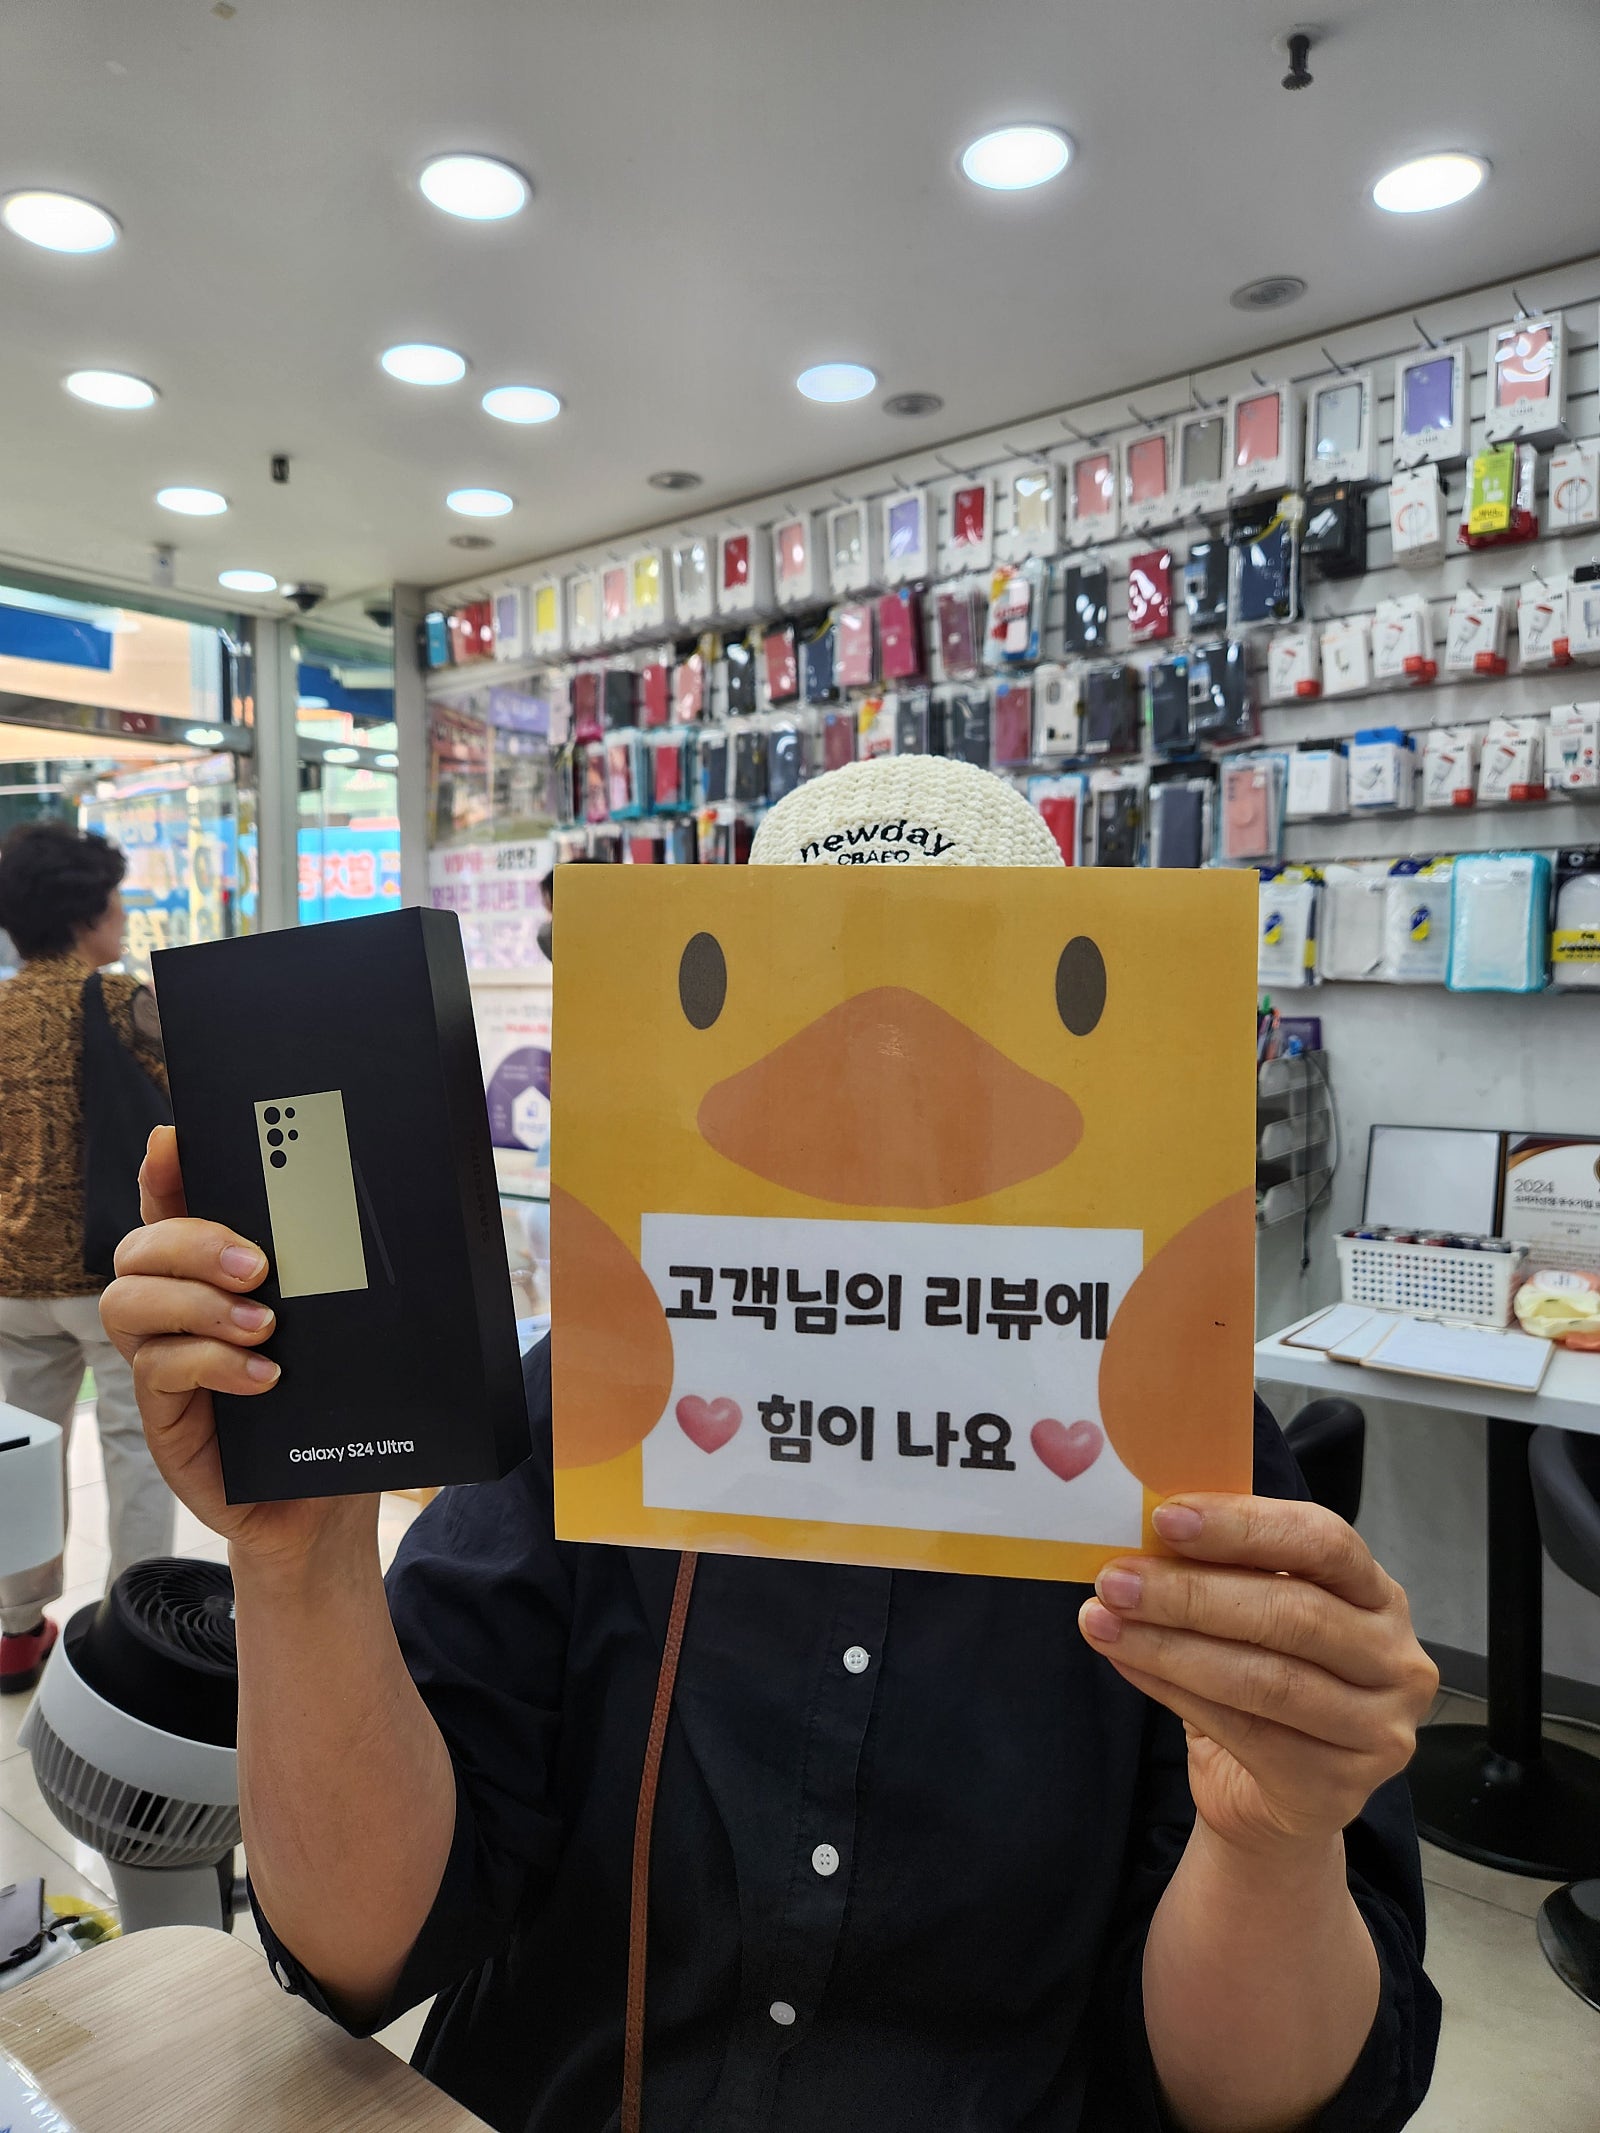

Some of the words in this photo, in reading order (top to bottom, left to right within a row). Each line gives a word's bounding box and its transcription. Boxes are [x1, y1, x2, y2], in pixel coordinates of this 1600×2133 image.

[800, 819, 956, 862] newday
[1513, 1178, 1554, 1194] 2024
[665, 1265, 902, 1335] 고객님의
[925, 1277, 1109, 1341] 리뷰에
[289, 1446, 345, 1462] Galaxy
[347, 1442, 375, 1458] S24
[377, 1439, 415, 1455] Ultra
[757, 1394, 875, 1464] 힘이
[897, 1411, 1016, 1472] 나요
